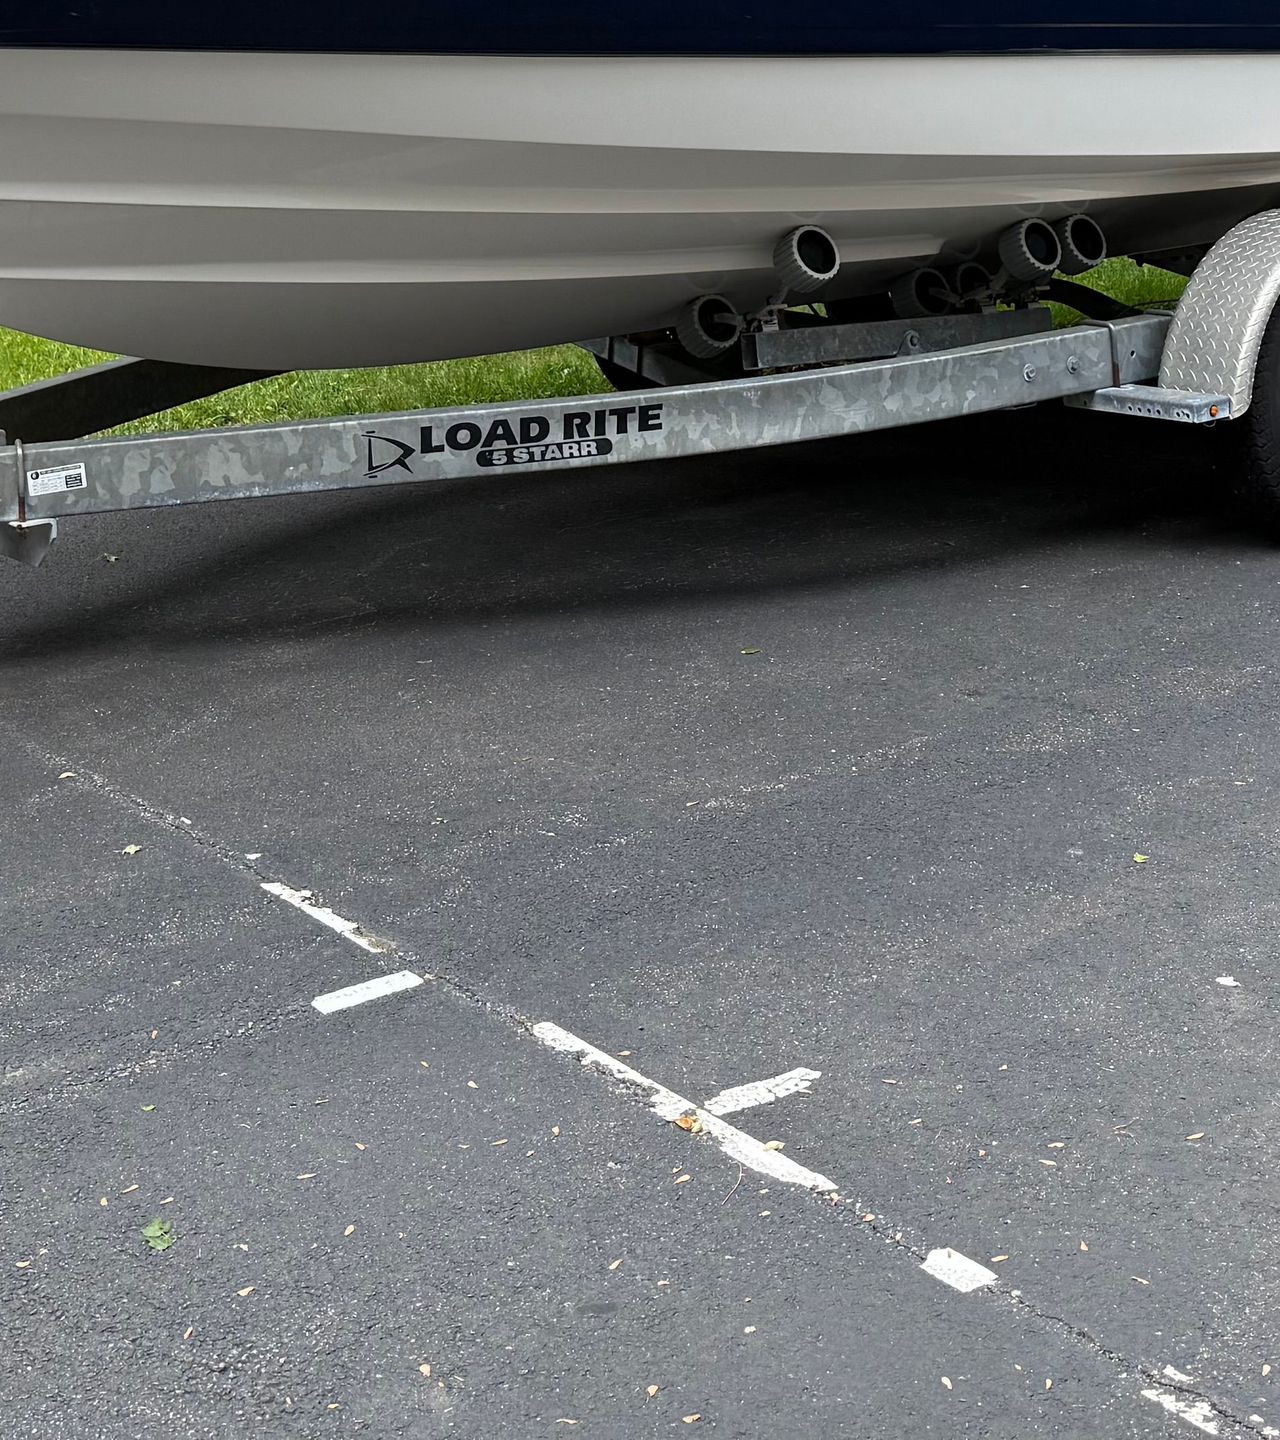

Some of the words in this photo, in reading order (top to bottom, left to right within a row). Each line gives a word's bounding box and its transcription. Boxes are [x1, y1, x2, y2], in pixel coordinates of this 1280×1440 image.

[420, 415, 551, 455] LOAD
[563, 403, 664, 440] RITE
[491, 449, 507, 465] 5
[512, 440, 599, 462] STARR
